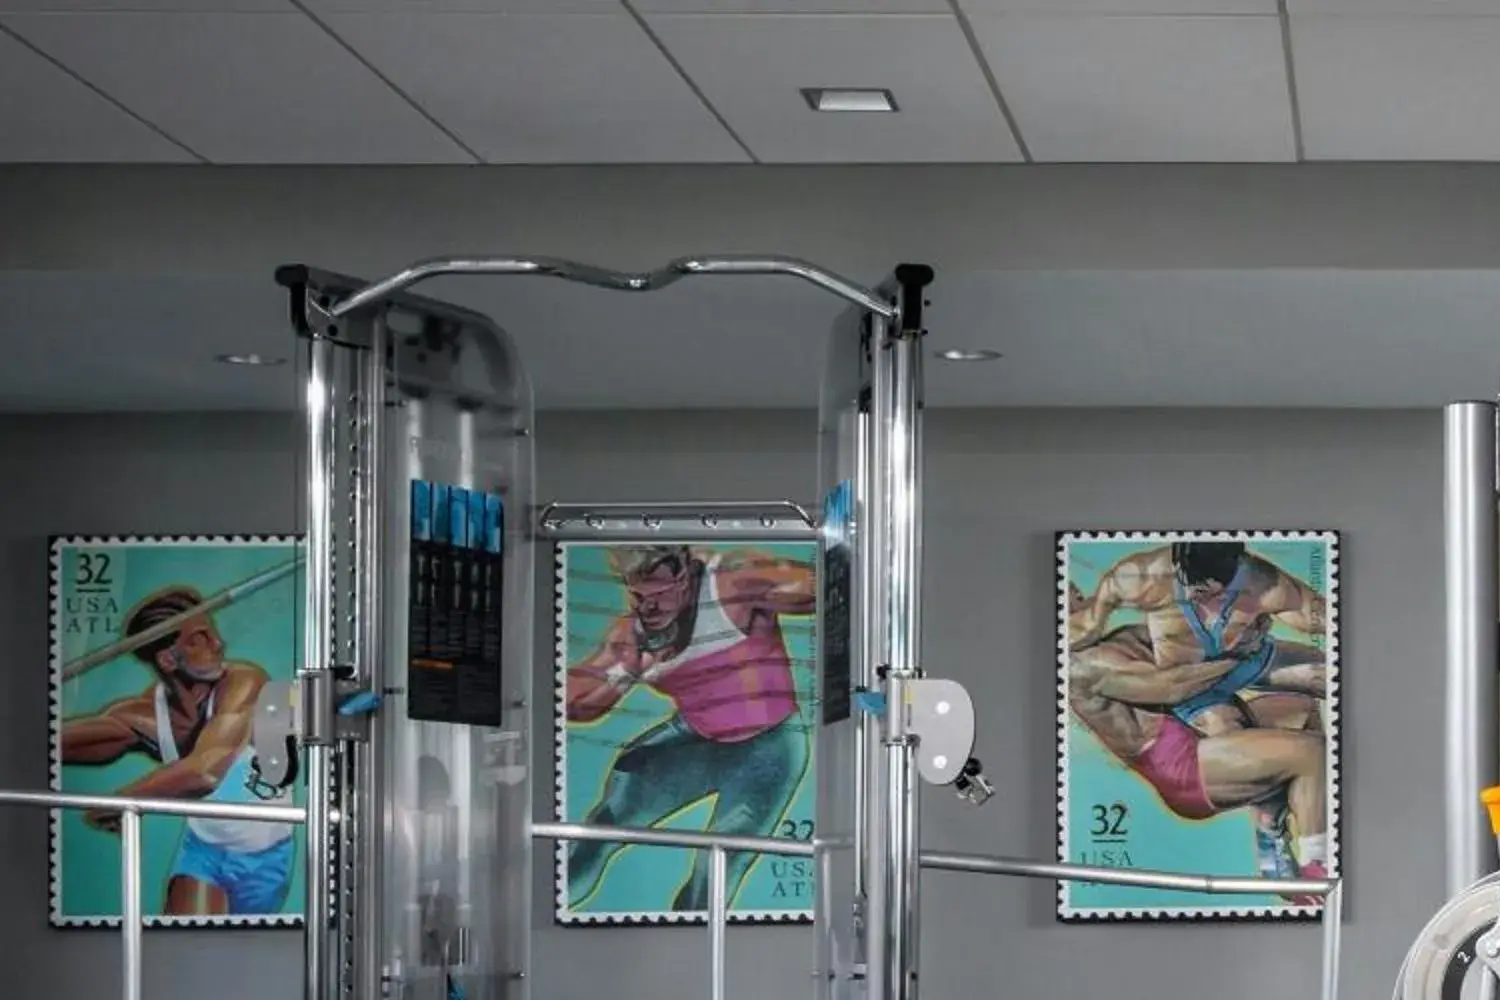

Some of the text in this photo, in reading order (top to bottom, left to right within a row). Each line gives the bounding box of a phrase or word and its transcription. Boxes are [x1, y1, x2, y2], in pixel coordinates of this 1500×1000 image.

[76, 552, 113, 585] 32
[66, 598, 119, 614] USA
[66, 617, 120, 634] ATL
[1090, 803, 1128, 835] 32
[771, 861, 813, 878] US
